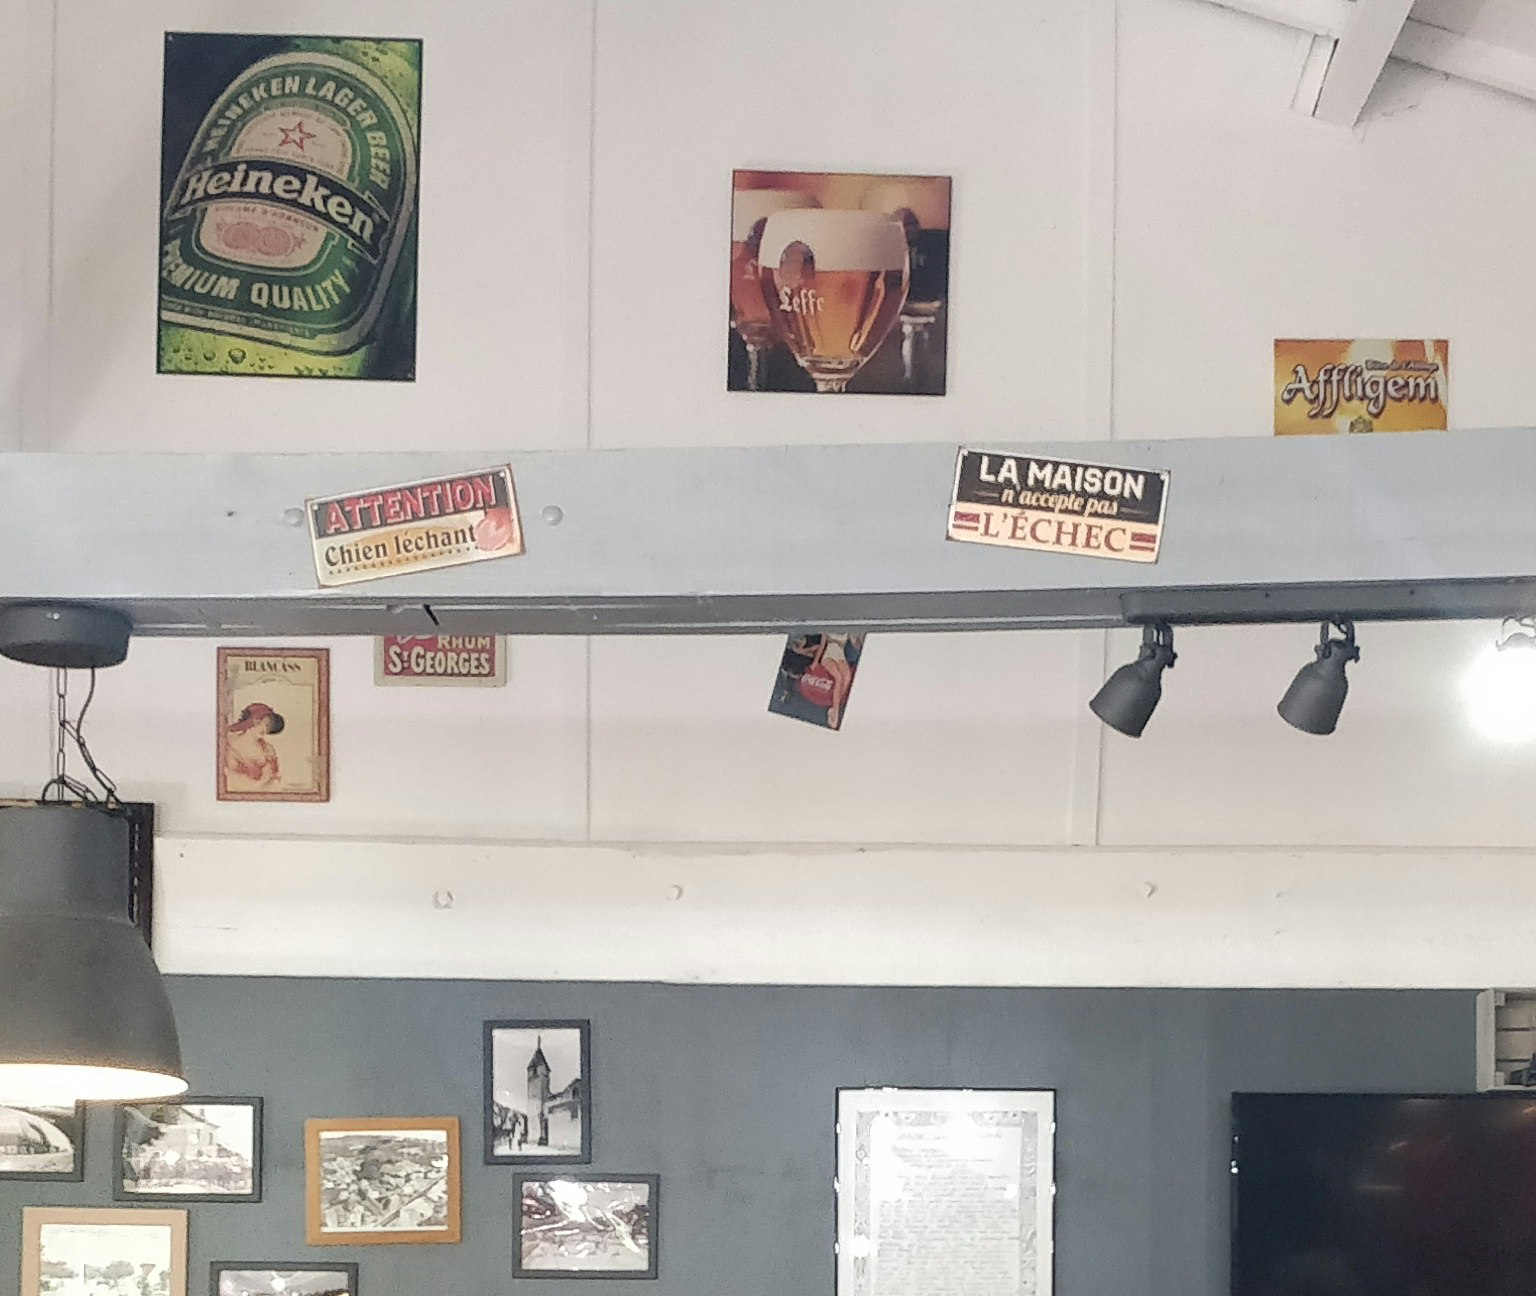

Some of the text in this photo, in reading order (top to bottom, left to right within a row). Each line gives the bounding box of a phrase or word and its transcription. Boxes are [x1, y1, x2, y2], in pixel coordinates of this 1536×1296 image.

[305, 77, 379, 127] LAGER
[367, 130, 392, 190] BEER
[179, 162, 375, 243] Heineken
[250, 268, 351, 311] QUALITY
[778, 286, 826, 315] Leffe
[1281, 363, 1441, 420] Affligem
[979, 455, 1145, 500] LA MAISON
[325, 474, 496, 534] ATTENTION
[1085, 498, 1119, 516] pas
[325, 525, 476, 567] Chien léchant
[979, 509, 1127, 552] L'ÉCHEC
[410, 646, 491, 674] GEORGES
[437, 633, 491, 650] RHUM
